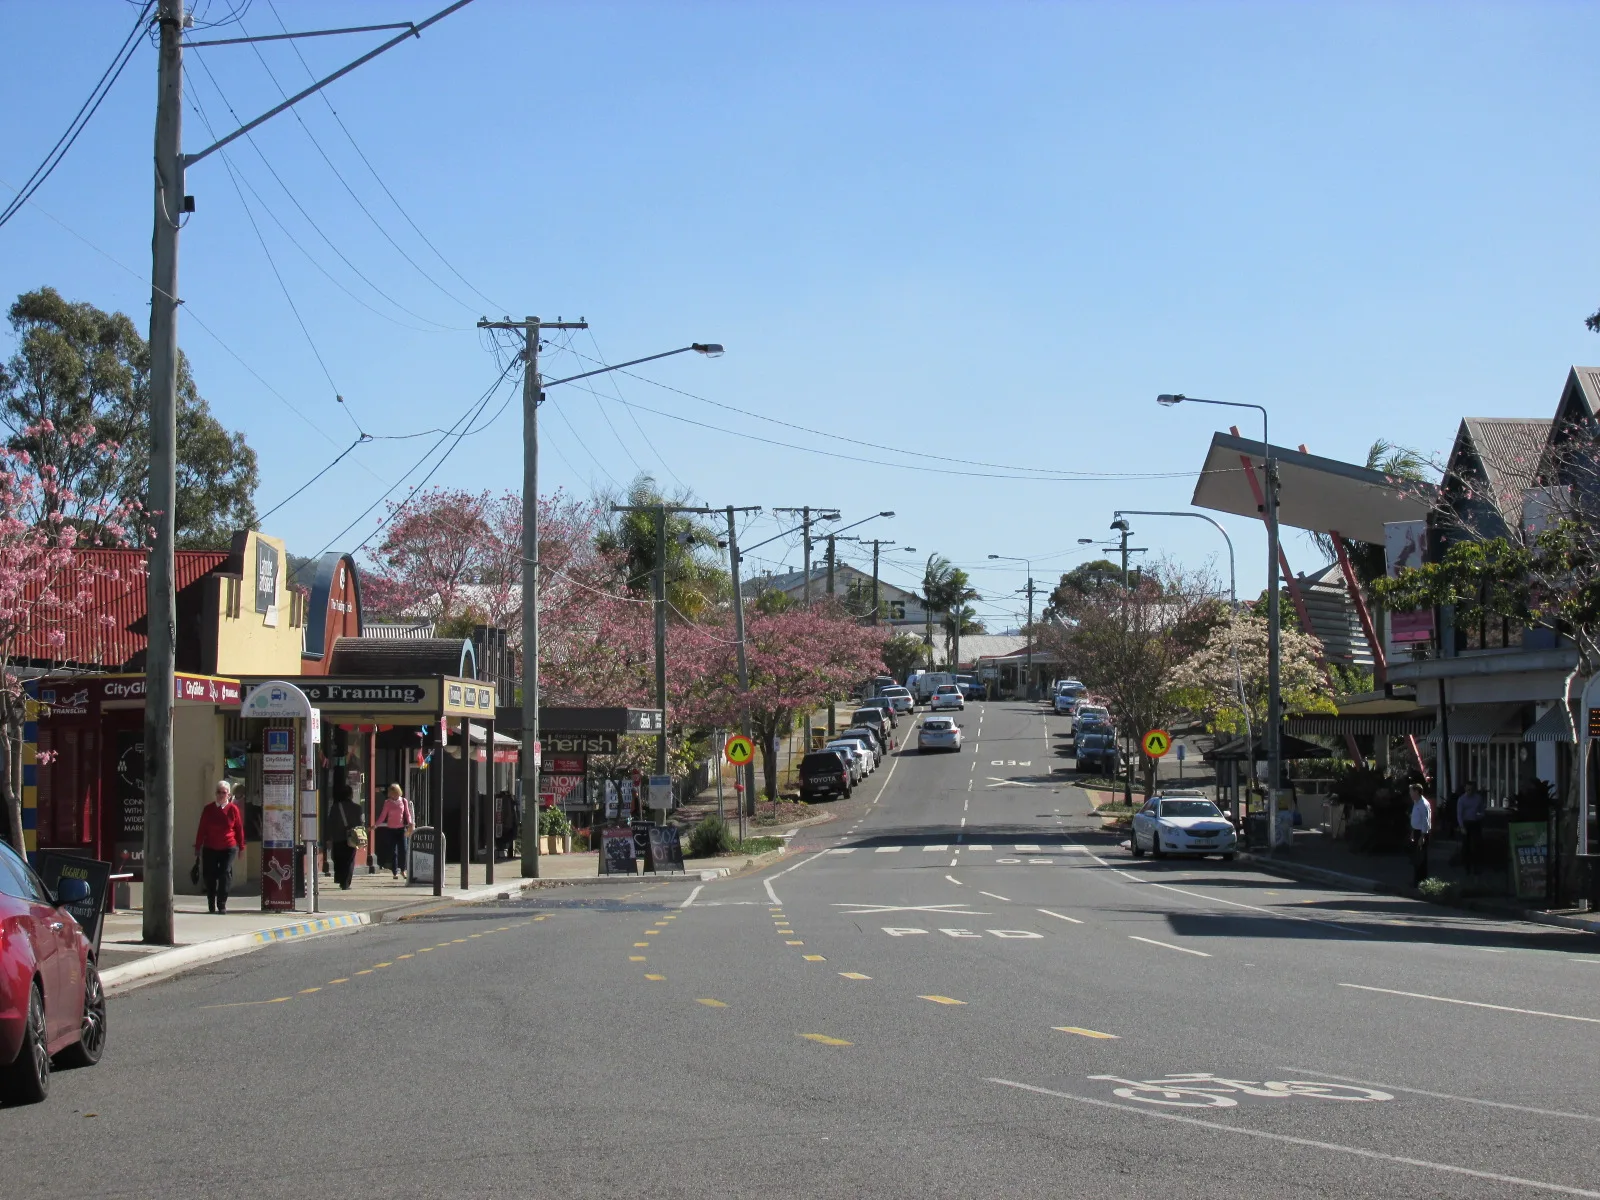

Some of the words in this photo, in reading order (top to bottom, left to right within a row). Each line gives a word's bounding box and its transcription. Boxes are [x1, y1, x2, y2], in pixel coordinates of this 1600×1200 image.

[327, 686, 416, 702] Framing
[540, 734, 612, 752] cherish
[550, 776, 580, 787] NOW
[809, 776, 836, 784] TOYOTA
[654, 846, 677, 861] OFF
[1520, 856, 1545, 864] BEER
[881, 927, 1045, 938] PED
